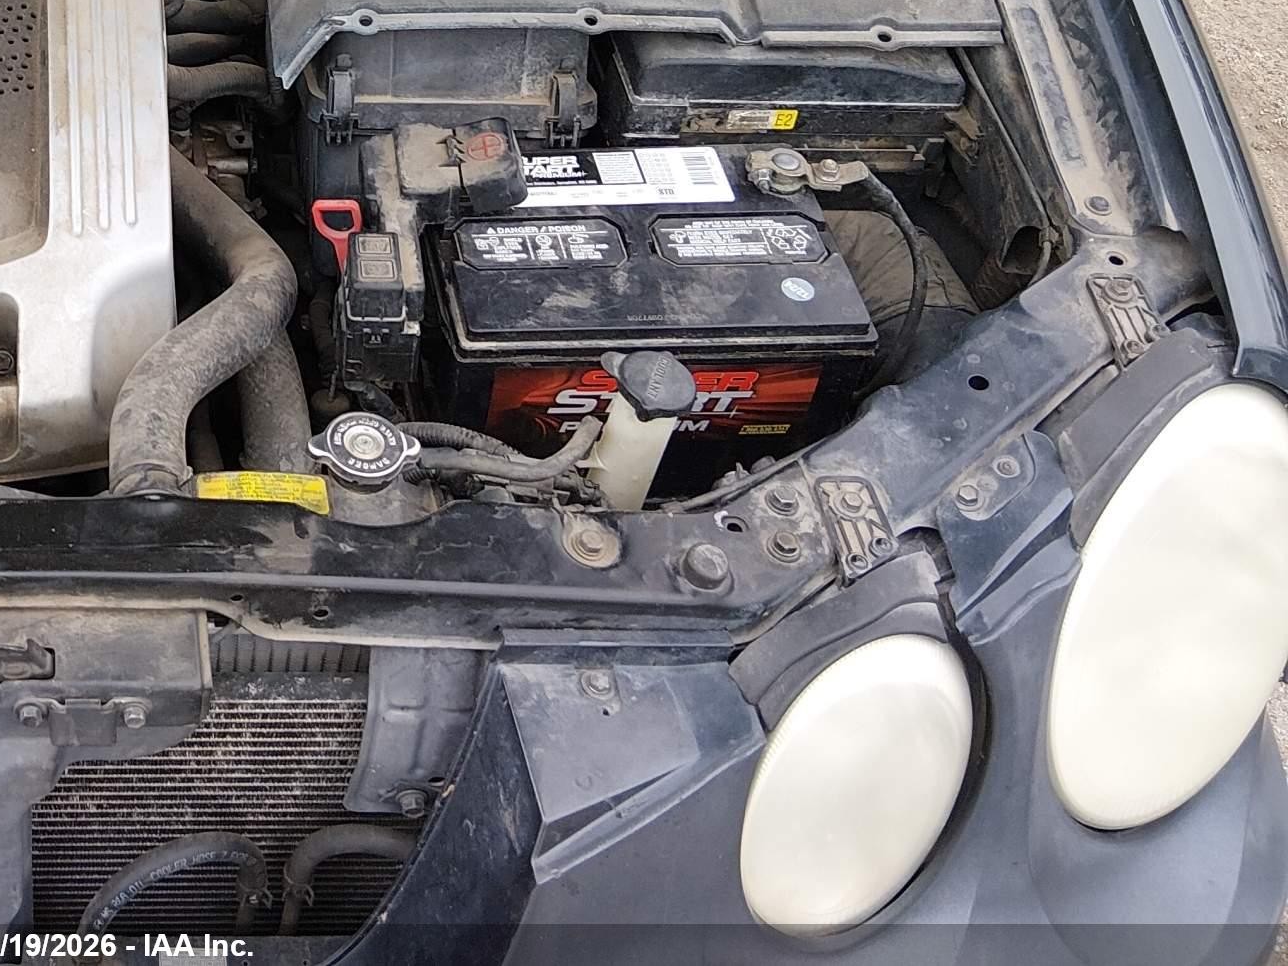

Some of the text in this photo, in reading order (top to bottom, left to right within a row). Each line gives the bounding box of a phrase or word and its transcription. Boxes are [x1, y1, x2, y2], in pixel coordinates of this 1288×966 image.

[774, 113, 793, 127] E2
[521, 156, 580, 167] UPER
[497, 226, 539, 234] DANGER
[548, 224, 586, 233] POISON
[576, 370, 760, 392] SER
[648, 355, 672, 400] COOLANT
